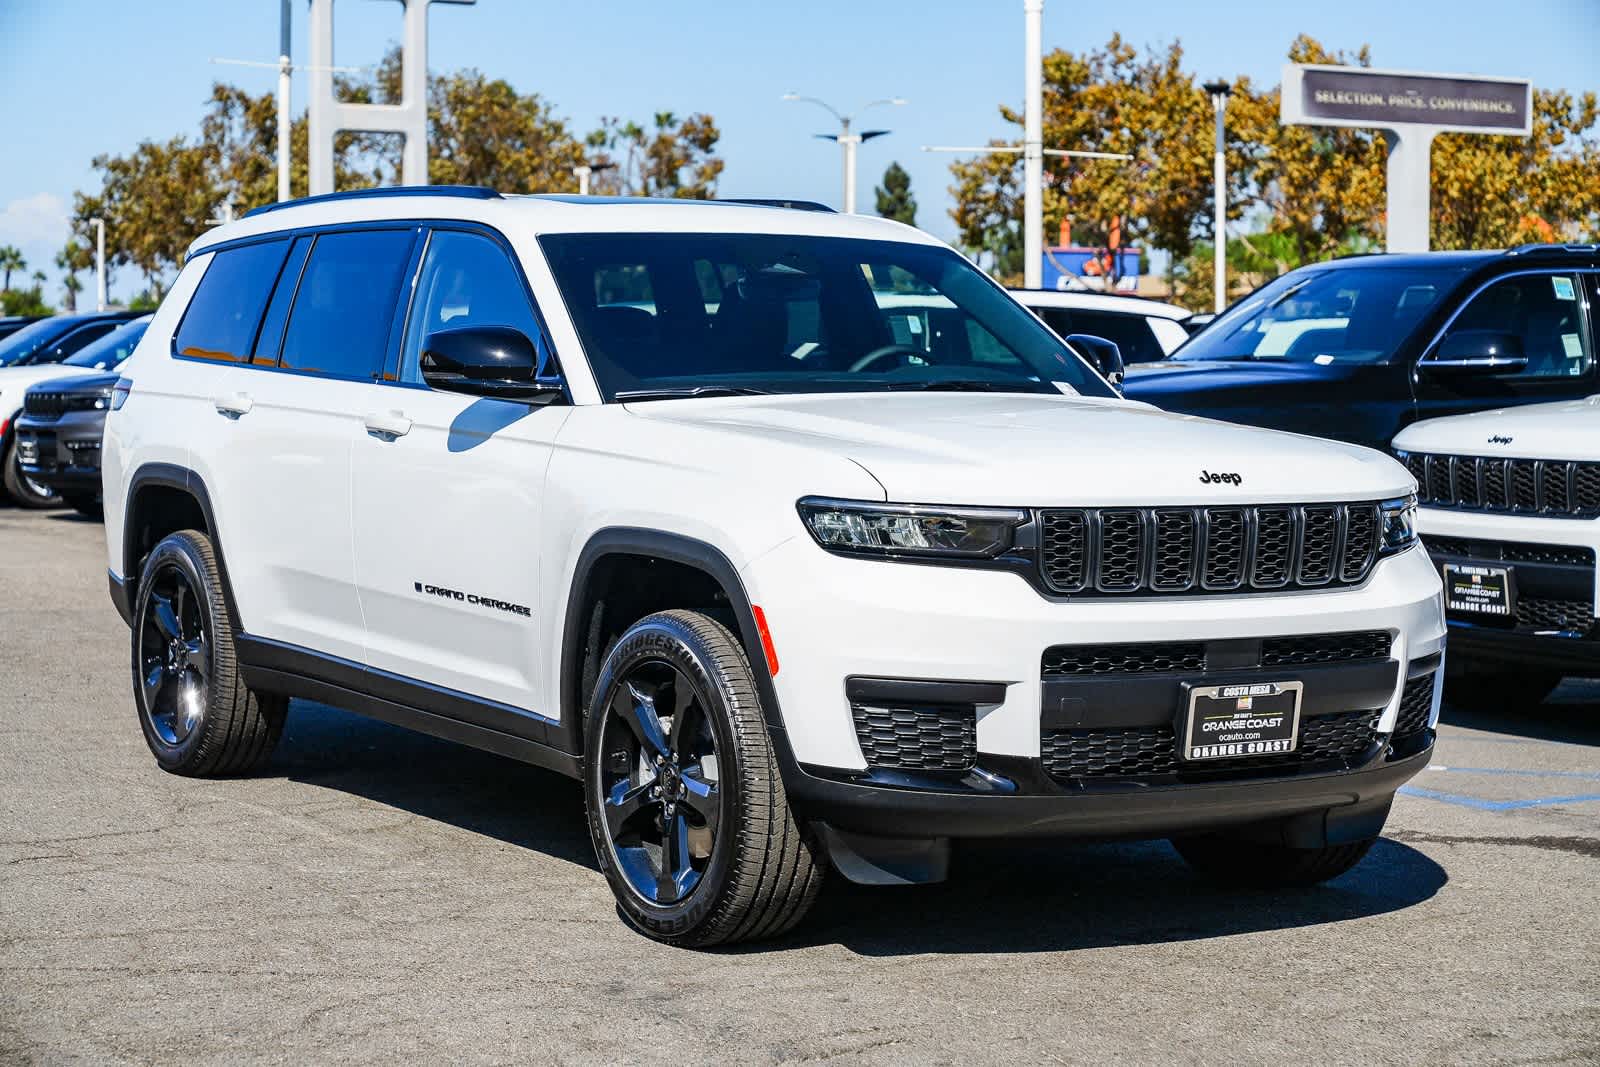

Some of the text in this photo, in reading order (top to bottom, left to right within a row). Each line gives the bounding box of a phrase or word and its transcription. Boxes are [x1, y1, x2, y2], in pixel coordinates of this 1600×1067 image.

[1314, 89, 1516, 113] SELECTION. PRICE. CONVENIENCE.
[1487, 435, 1513, 446] Jeep
[1199, 470, 1242, 486] Jeep
[424, 584, 531, 617] GRAND CHEROKEE
[1224, 684, 1270, 696] COSTA MESA
[1202, 717, 1283, 732] ORANGE COAST
[1219, 732, 1260, 741] ocauto.com
[1193, 741, 1289, 757] ORANGE COAST
